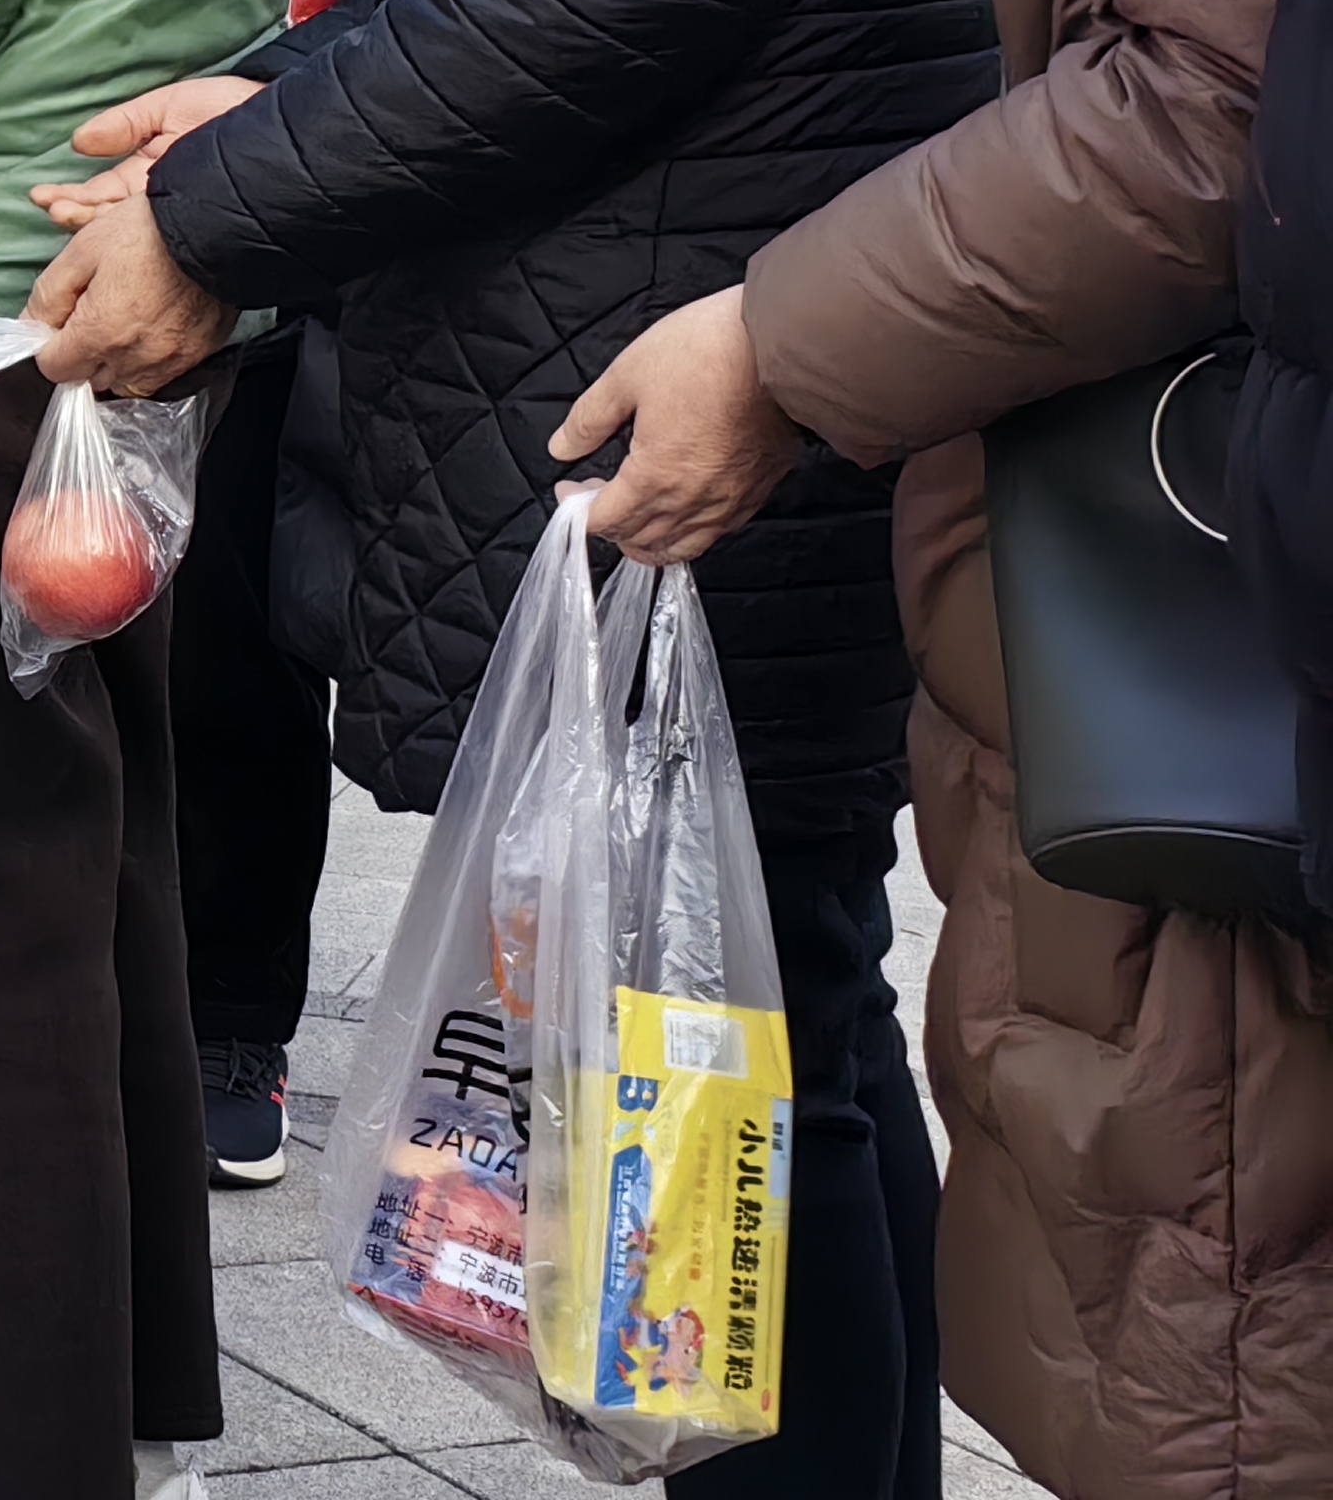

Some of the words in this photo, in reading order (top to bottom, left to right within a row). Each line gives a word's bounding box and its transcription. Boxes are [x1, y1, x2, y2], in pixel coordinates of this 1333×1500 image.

[724, 1118, 766, 1390] 小儿热速清颗粒
